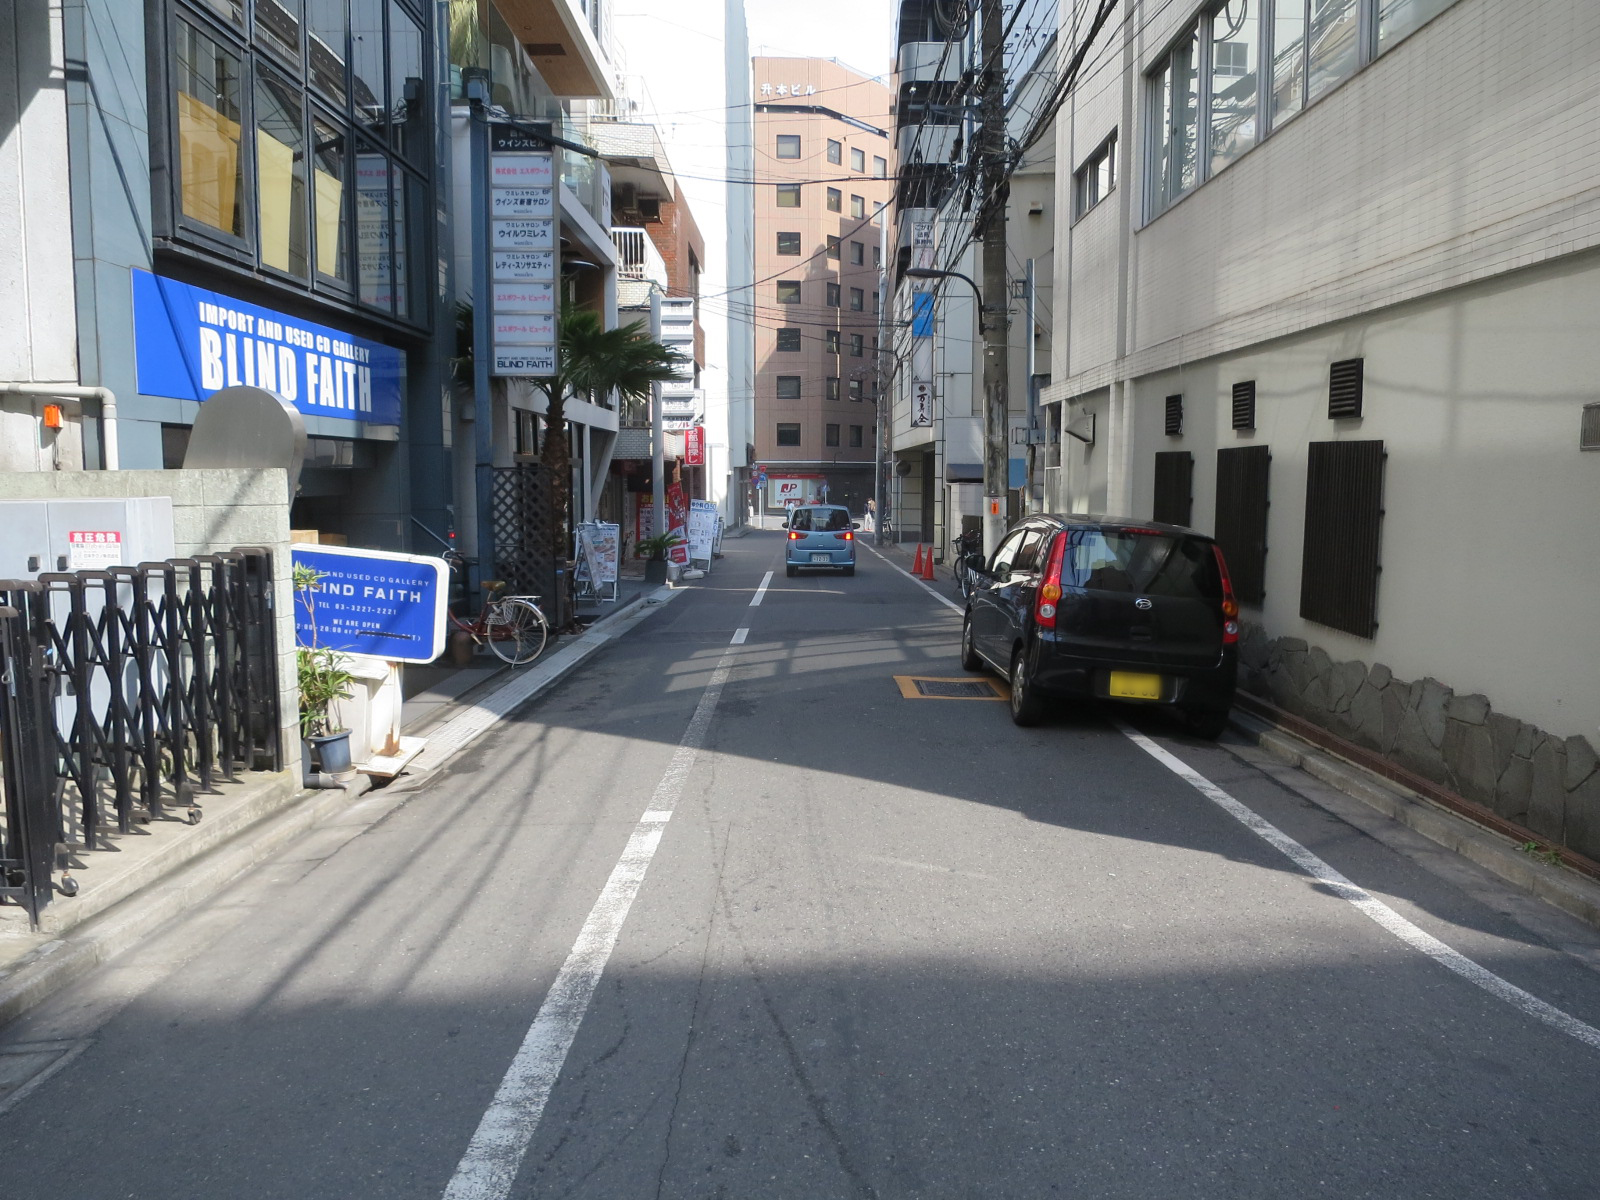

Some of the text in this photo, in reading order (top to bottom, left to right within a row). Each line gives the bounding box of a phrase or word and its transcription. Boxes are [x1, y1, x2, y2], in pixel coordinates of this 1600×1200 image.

[498, 229, 548, 238] ウイルワミレス
[198, 301, 370, 364] IMPORT AND USED CD GALLERY
[199, 326, 372, 413] BLIND FAITH
[497, 360, 553, 368] BLIND FAITH
[780, 483, 798, 493] JP
[347, 572, 371, 581] USED
[374, 575, 386, 583] CD
[388, 577, 430, 587] GALLERY
[363, 586, 422, 603] FAITH
[318, 601, 397, 615] TEL 03-3227-2221
[332, 618, 381, 629] WE ARE OPEN
